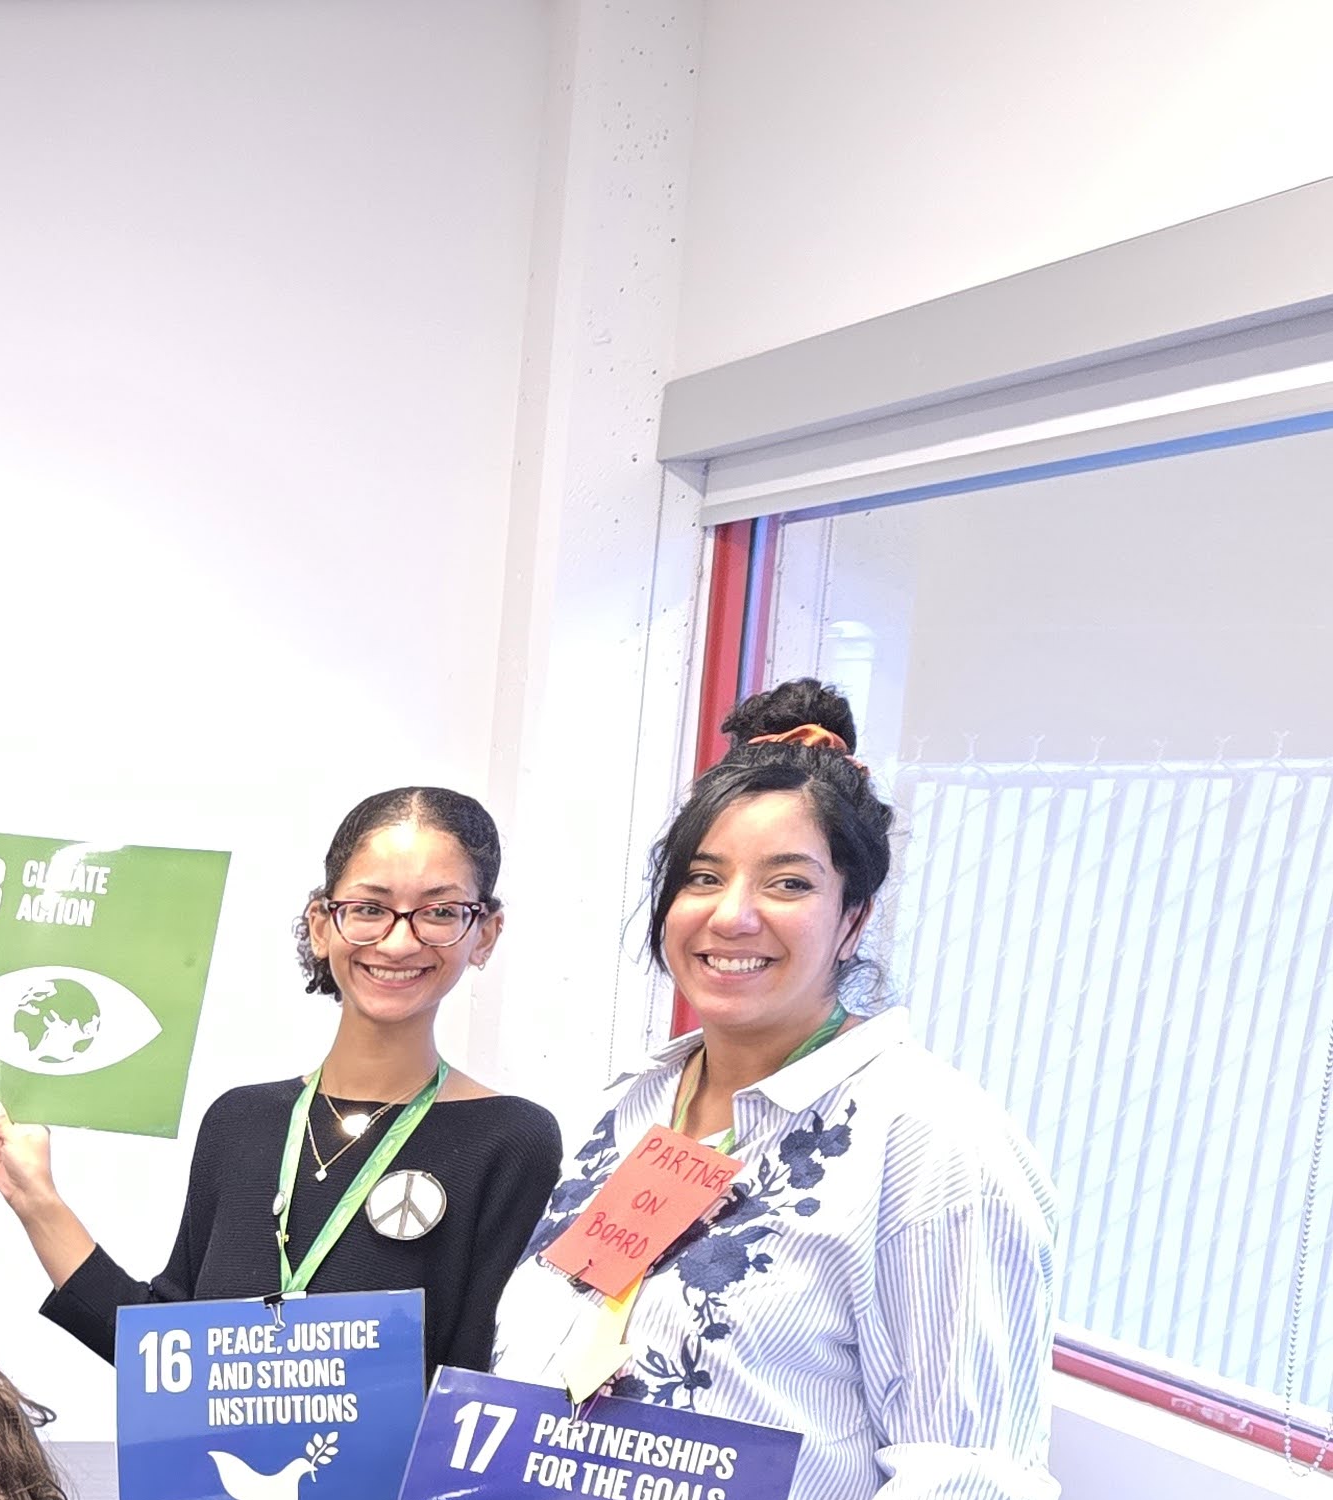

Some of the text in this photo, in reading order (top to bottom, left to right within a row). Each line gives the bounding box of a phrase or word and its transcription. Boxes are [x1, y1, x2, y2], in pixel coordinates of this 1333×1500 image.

[16, 893, 96, 927] ACTION
[637, 1137, 733, 1193] PARTNER
[632, 1189, 667, 1215] ON
[586, 1211, 648, 1259] BOARD
[207, 1319, 380, 1355] PEACE, JUSTICE
[138, 1328, 193, 1394] 16
[208, 1357, 346, 1391] AND STRONG
[208, 1393, 358, 1426] INSTITUTIONS
[449, 1400, 517, 1474] 17
[533, 1413, 738, 1480] PARTNERSHIPS
[522, 1451, 578, 1491] FOR
